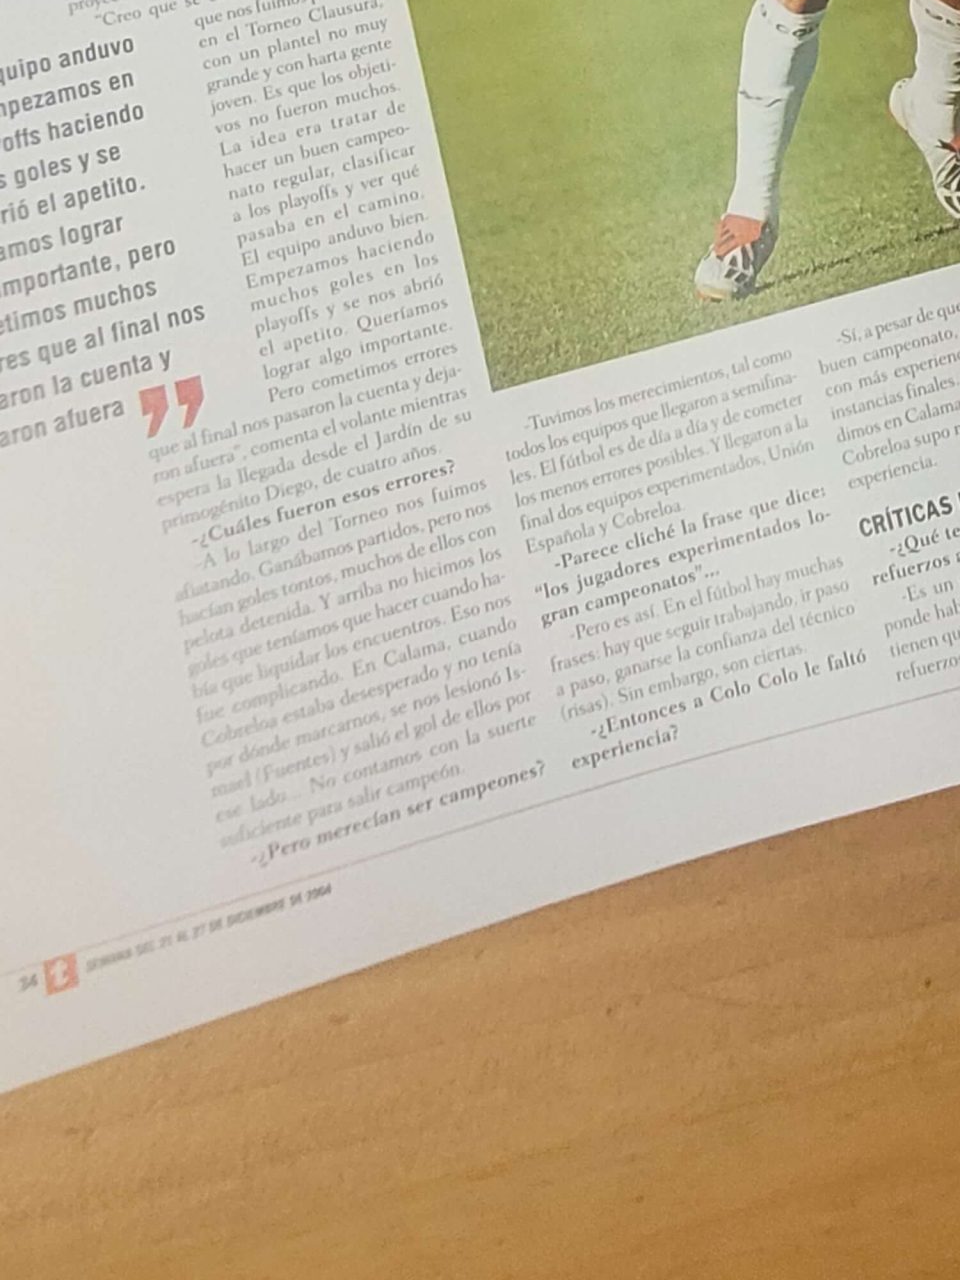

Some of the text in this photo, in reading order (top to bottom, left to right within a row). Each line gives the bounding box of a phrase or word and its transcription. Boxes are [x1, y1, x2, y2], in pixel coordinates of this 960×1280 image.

[58, 37, 134, 68] anduvo
[108, 72, 134, 91] en
[46, 103, 144, 141] haciendo
[13, 157, 72, 189] goles
[77, 152, 89, 174] y
[95, 145, 121, 165] se
[36, 192, 57, 215] el
[63, 176, 145, 210] apetito.
[58, 215, 123, 246] lograr
[240, 212, 429, 267] El equipo anduvo bien.
[127, 239, 176, 270] pero
[73, 280, 157, 316] muchos
[37, 337, 77, 365] que
[83, 325, 105, 350] al
[110, 311, 160, 343] final
[166, 304, 205, 328] nos
[51, 374, 73, 395] la
[79, 354, 153, 388] cuenta
[158, 349, 171, 372] y
[267, 344, 458, 403] Pero cometimos errores
[53, 399, 125, 433] afuera
[554, 487, 825, 569] -Parece cliché la frase que dice:
[858, 496, 953, 537] CRÍTICAS
[534, 509, 830, 599] “los jugadores experimentados lo-
[889, 528, 939, 558] -¿Qué
[944, 527, 960, 540] te
[872, 555, 951, 586] refuerzos
[540, 570, 719, 629] gran campeonatos”...
[251, 763, 545, 868] -¿Pero merecían ser campeones?
